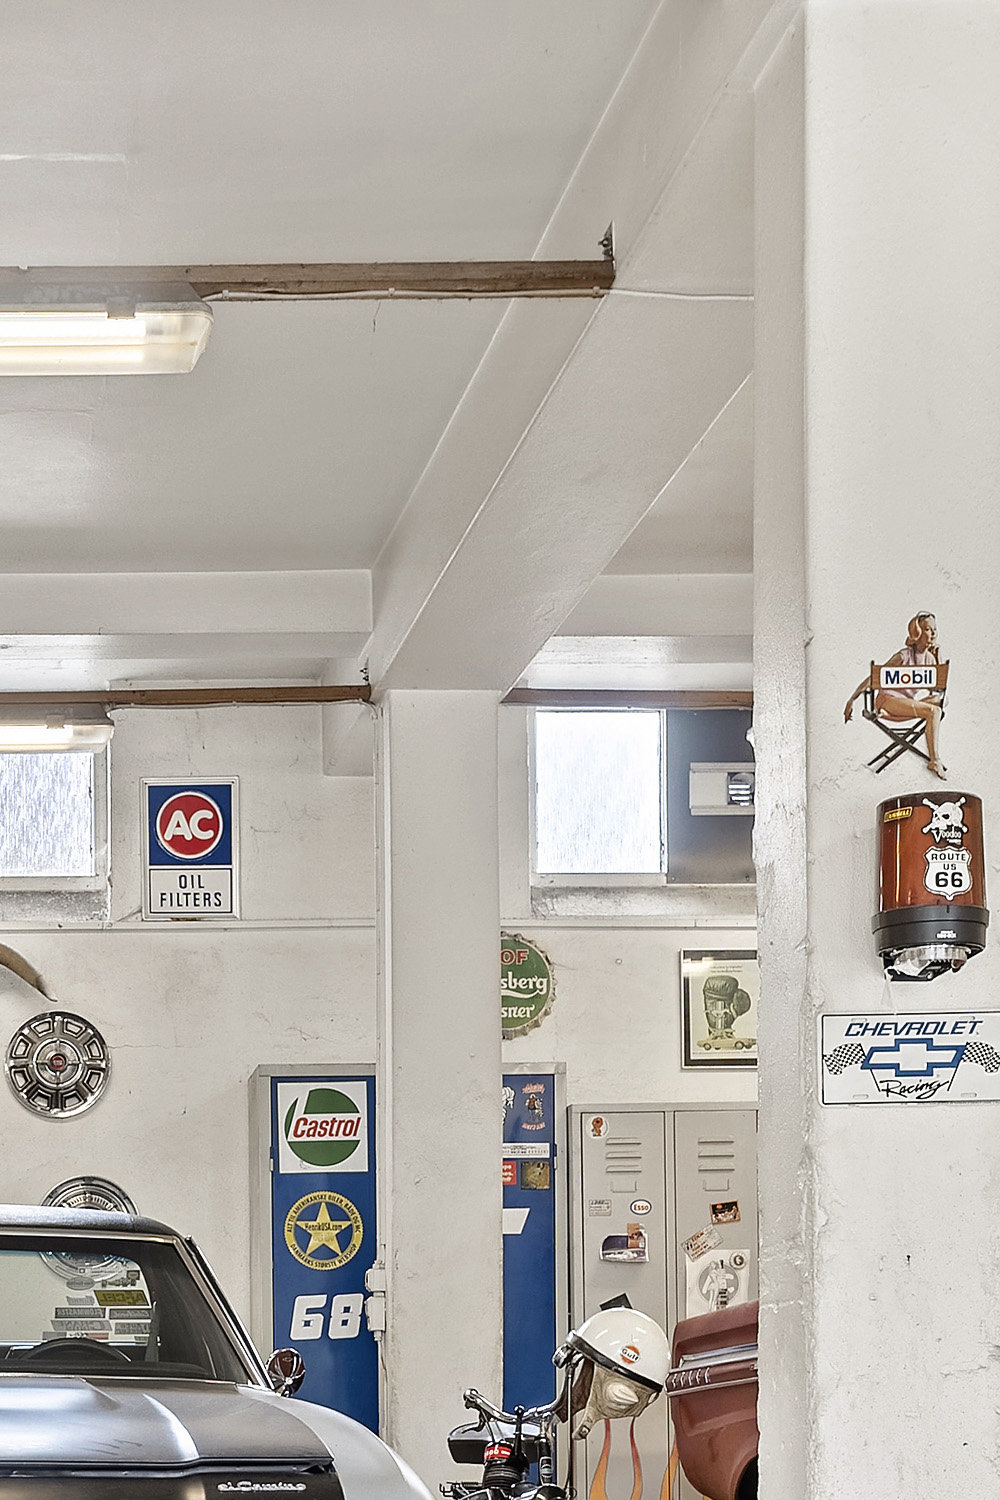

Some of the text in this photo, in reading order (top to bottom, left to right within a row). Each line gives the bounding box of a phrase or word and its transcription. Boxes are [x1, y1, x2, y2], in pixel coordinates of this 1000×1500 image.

[884, 670, 932, 685] Mobil
[164, 809, 215, 841] AC
[931, 825, 962, 843] Voodoo
[931, 853, 966, 861] ROUTE
[943, 863, 957, 871] US
[178, 874, 205, 889] OIL
[935, 871, 964, 888] 66
[160, 892, 222, 907] FILTERS
[501, 949, 529, 965] OF
[501, 971, 547, 995] sberg
[501, 1004, 535, 1018] sner
[844, 1020, 984, 1037] CHEVROLET
[879, 1078, 950, 1100] Racing
[293, 1117, 361, 1138] Castrol
[289, 1293, 364, 1341] 68
[621, 1348, 639, 1361] Gulf
